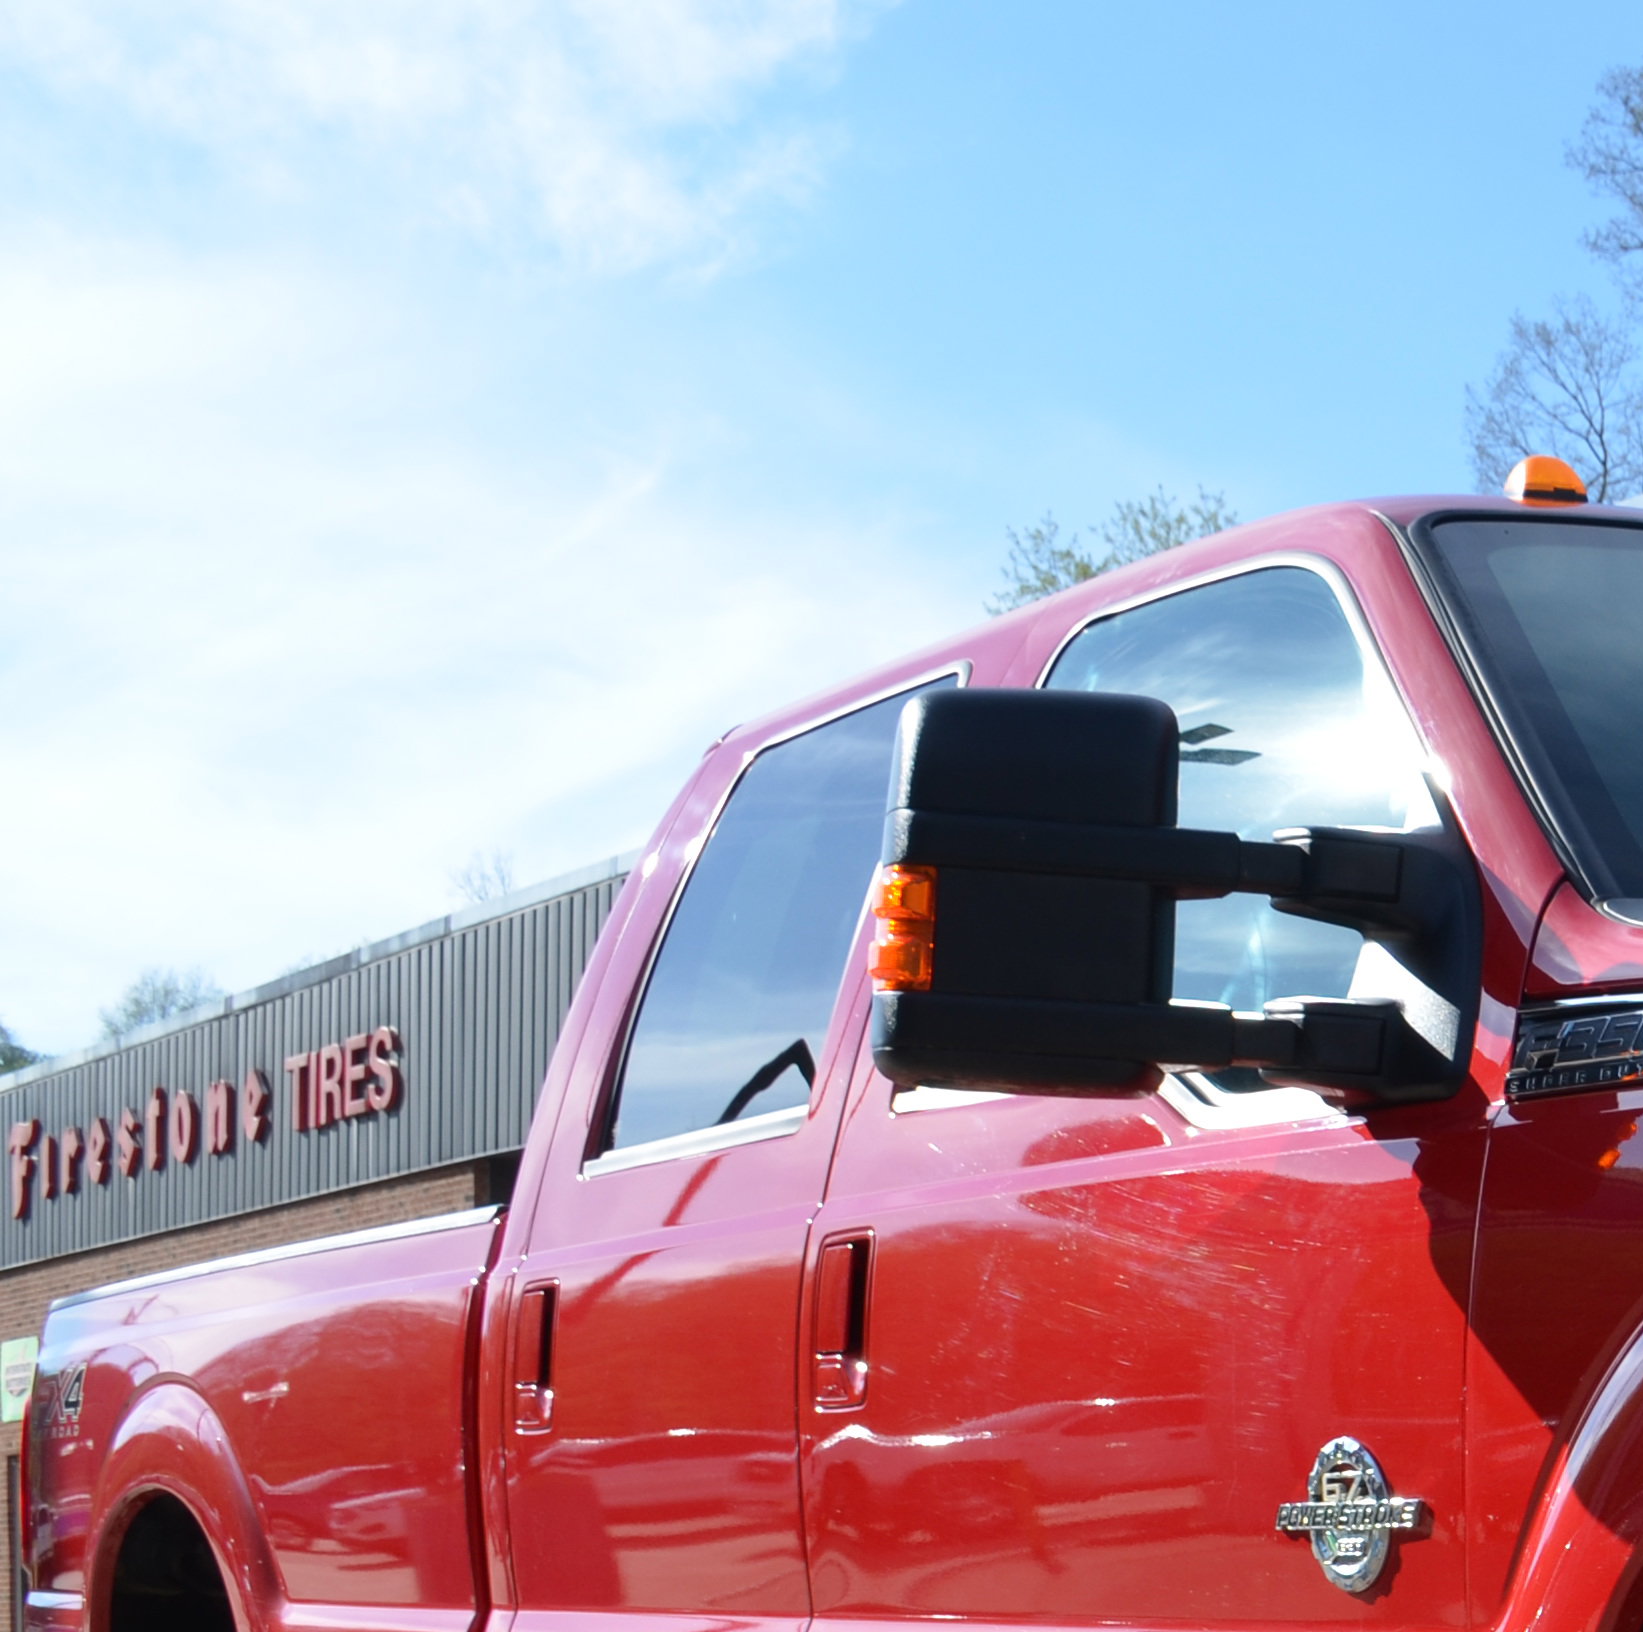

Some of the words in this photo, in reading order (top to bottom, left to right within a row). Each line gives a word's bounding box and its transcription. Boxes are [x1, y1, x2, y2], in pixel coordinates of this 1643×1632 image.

[9, 1067, 273, 1220] Firestone
[284, 1025, 403, 1132] TIRES
[1278, 1504, 1334, 1527] POWER
